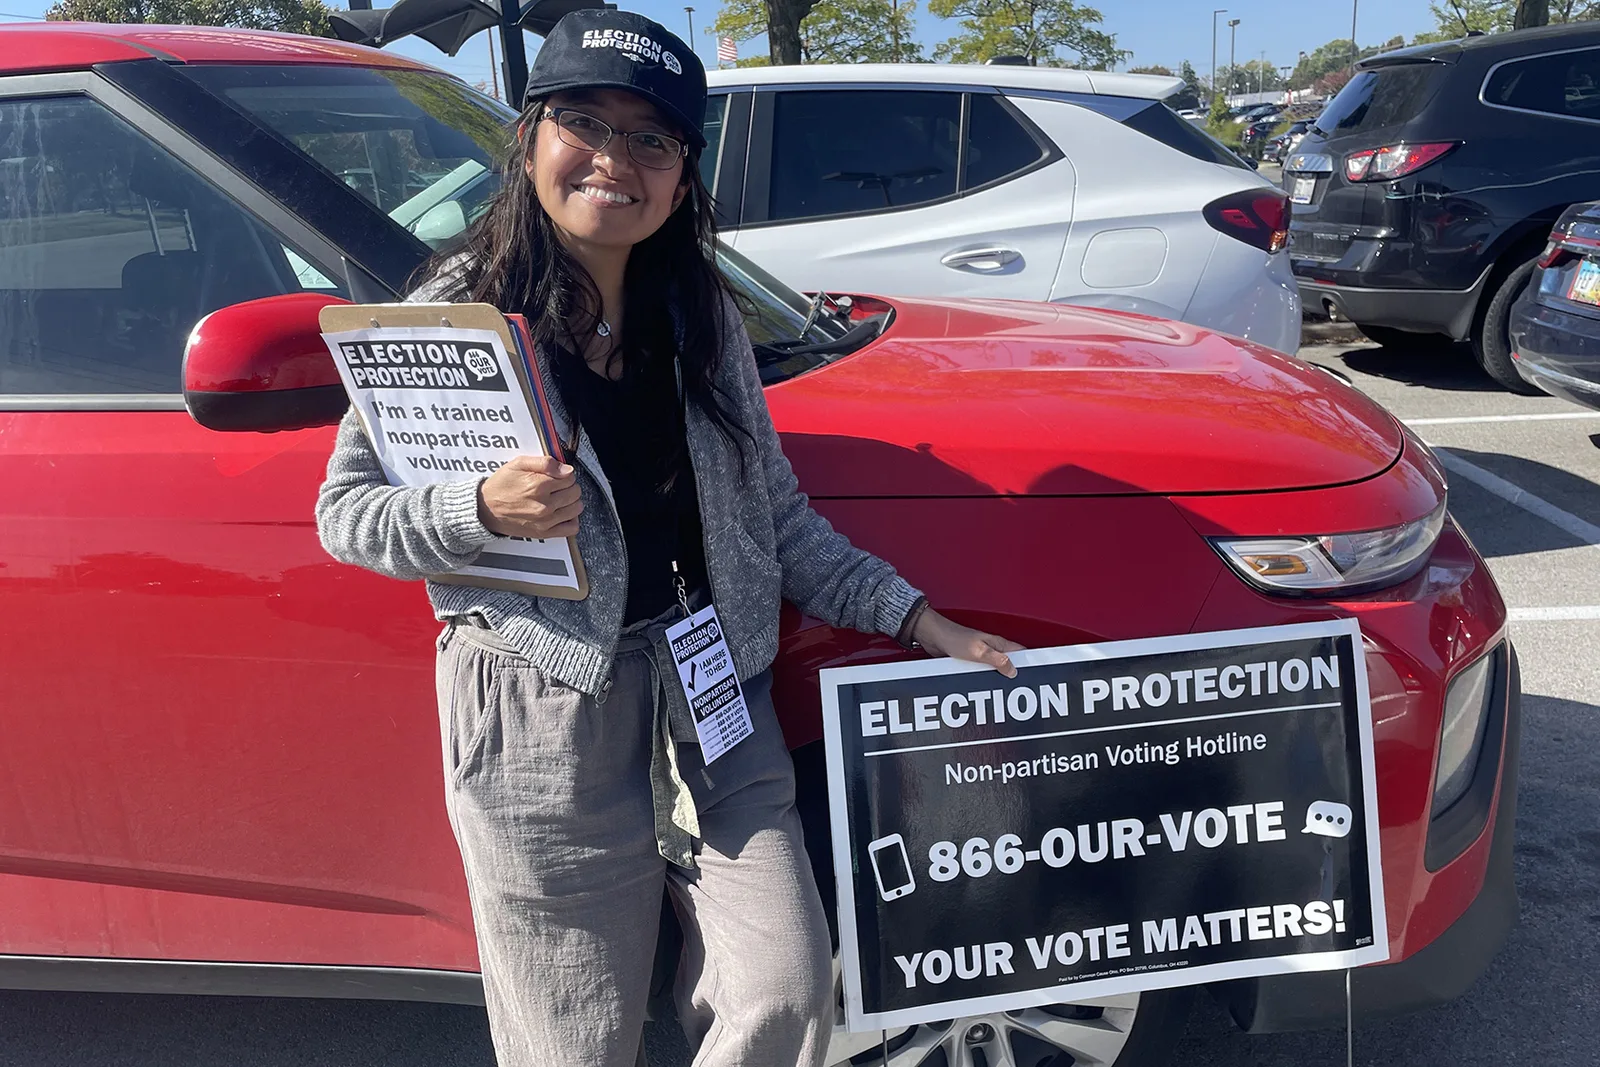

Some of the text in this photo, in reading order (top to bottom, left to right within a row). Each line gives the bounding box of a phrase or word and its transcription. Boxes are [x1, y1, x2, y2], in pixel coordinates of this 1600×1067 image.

[582, 38, 660, 63] PROTECTION
[583, 29, 662, 54] ELECTION
[341, 344, 462, 365] ELECTION
[470, 357, 491, 368] OUR
[352, 367, 470, 387] PROTECTION
[477, 366, 495, 375] VOTE
[413, 406, 427, 420] a
[431, 403, 514, 423] trained
[387, 430, 519, 450] nonpartisan
[673, 627, 708, 652] ELECTION
[676, 636, 711, 661] PROTECTION
[703, 657, 712, 668] AM
[711, 648, 727, 663] HERE
[704, 659, 728, 678] TO HELP
[693, 677, 735, 709] NONPARTISAN
[699, 689, 735, 716] VOLUNTEER
[859, 655, 1341, 738] ELECTION PROTECTION
[944, 732, 1267, 786] Non-partisan Voting Hotline
[928, 801, 1287, 883] 866-OUR-VOTE
[894, 899, 1346, 990] YOUR VOTE MATTERS!
